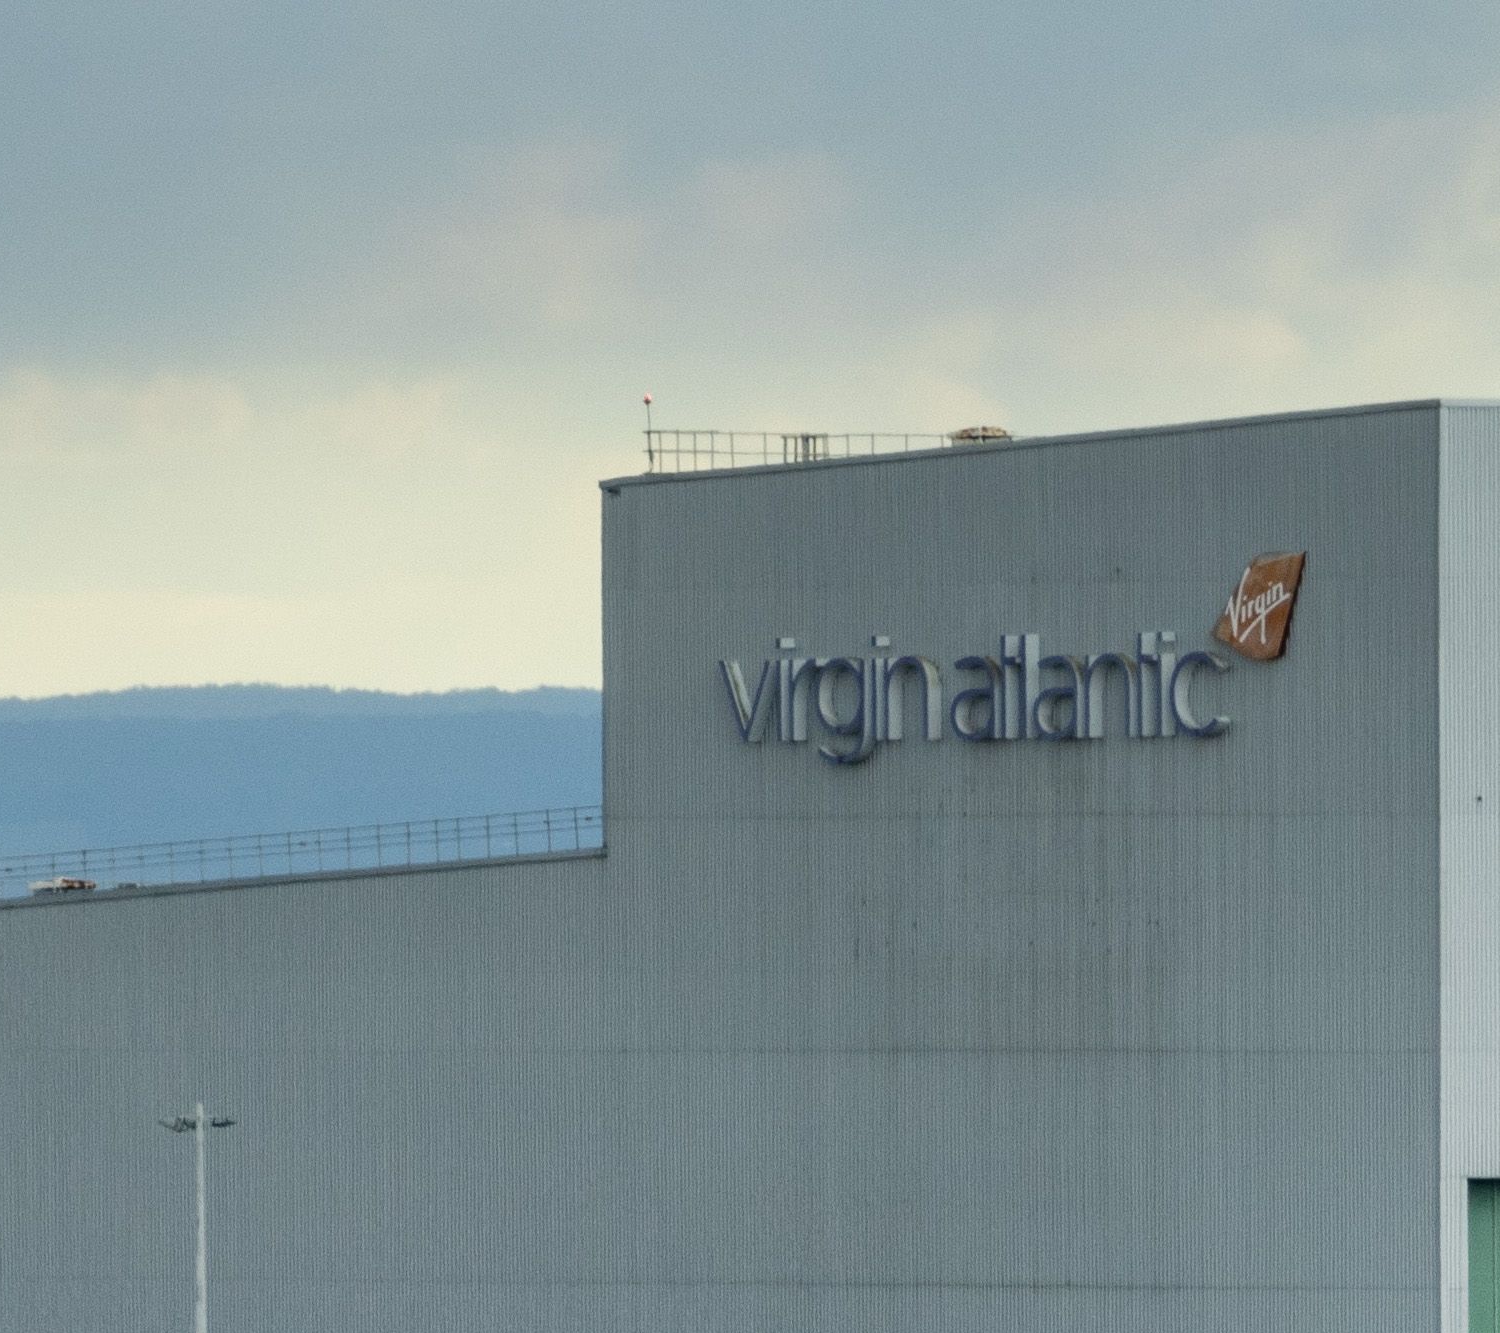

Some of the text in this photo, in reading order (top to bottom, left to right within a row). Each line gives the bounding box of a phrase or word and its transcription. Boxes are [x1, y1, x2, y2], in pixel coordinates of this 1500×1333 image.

[1225, 567, 1292, 646] Virgin
[718, 632, 1232, 766] virgin atlantic
